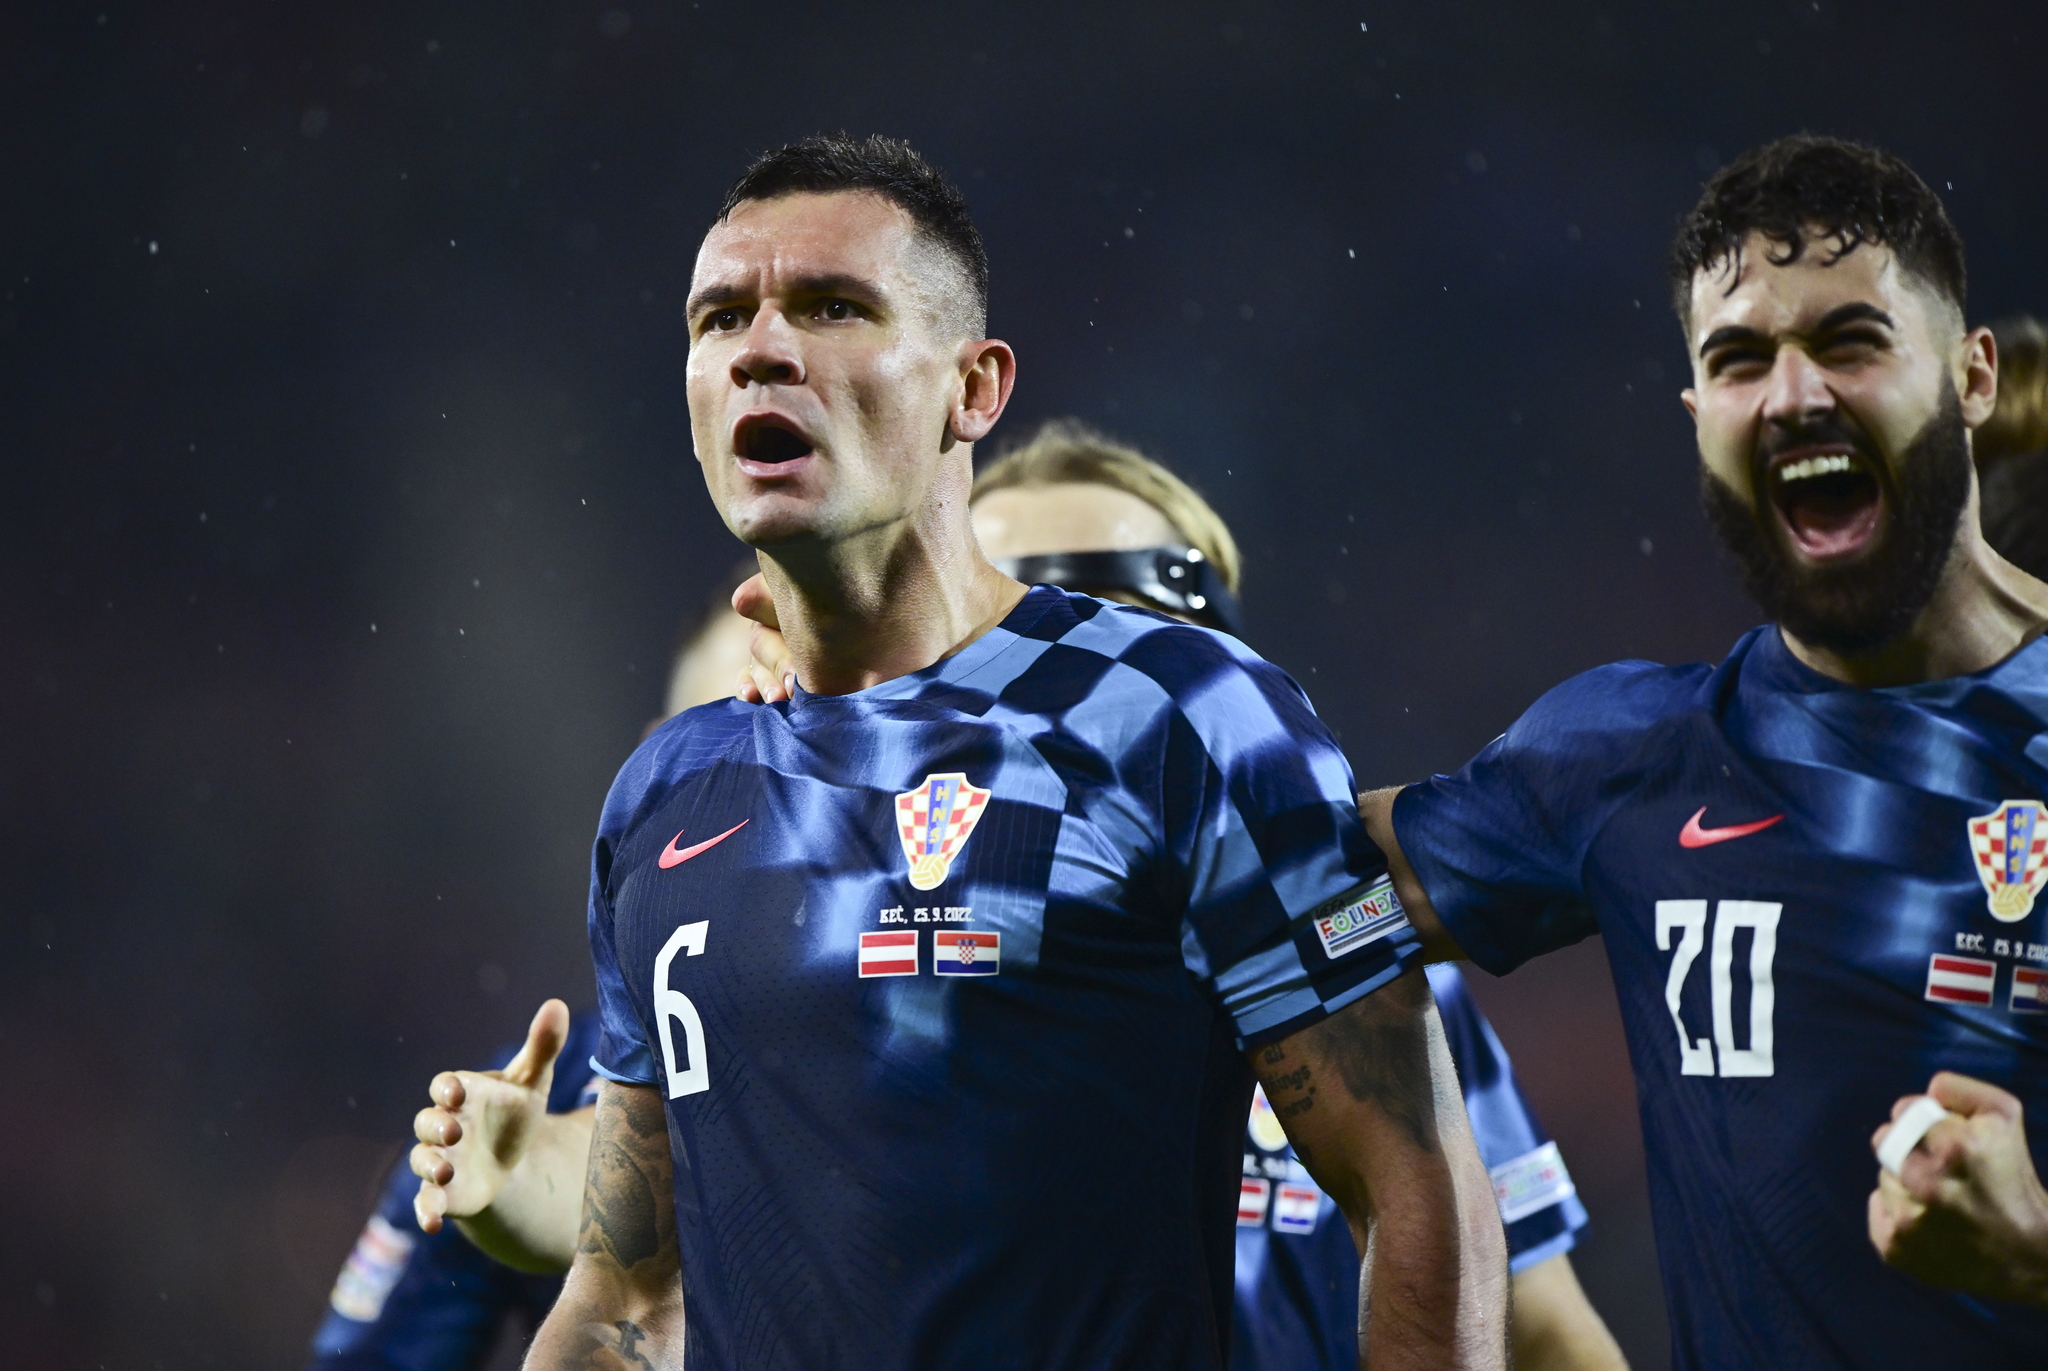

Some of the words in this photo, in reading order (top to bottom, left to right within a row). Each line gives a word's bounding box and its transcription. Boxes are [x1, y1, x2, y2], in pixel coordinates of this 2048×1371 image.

[930, 786, 950, 843] HNS
[653, 920, 709, 1100] 6
[1655, 899, 1783, 1077] 20
